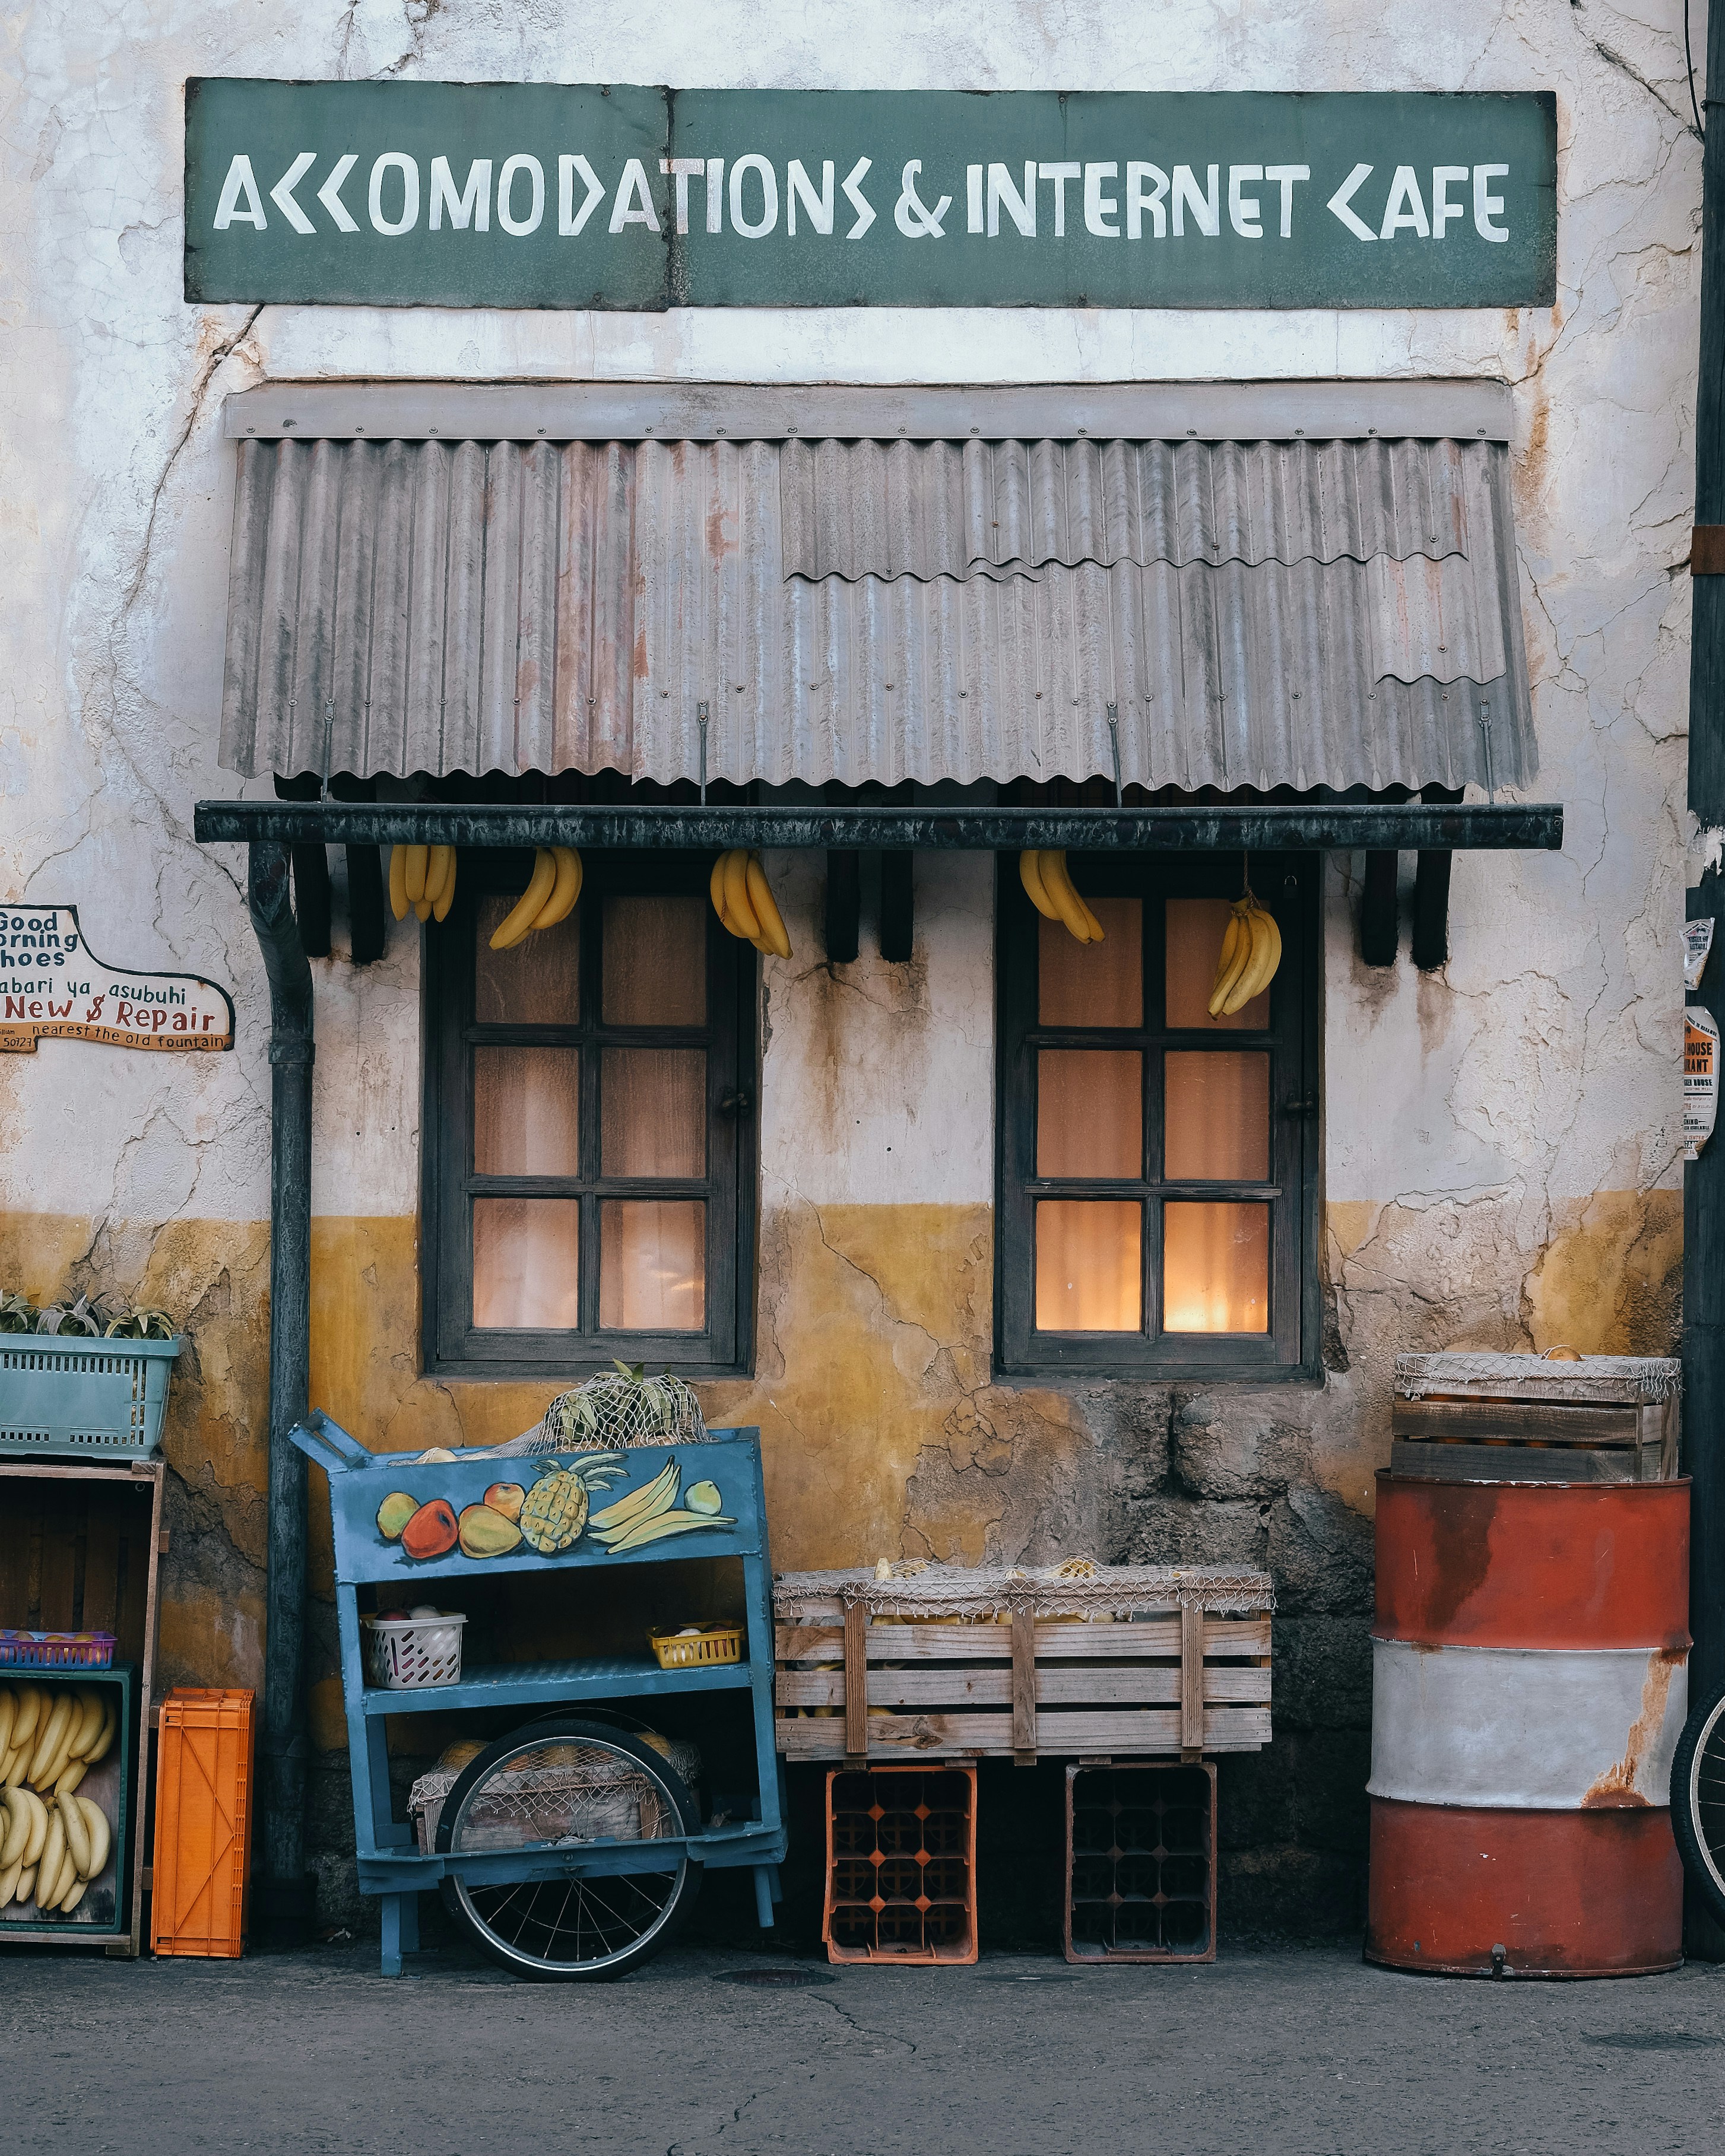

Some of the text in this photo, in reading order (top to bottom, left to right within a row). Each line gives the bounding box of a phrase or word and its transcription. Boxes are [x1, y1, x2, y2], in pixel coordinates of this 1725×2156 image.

[212, 151, 1510, 243] ACCOMODATIONS & INTERNET CAFE
[0, 912, 58, 931] Good
[67, 981, 91, 998] ya
[109, 984, 186, 1005] asubuhi
[5, 995, 74, 1019] New
[115, 1001, 215, 1033] Repair
[32, 1025, 224, 1047] nearest the old fountain
[1687, 1042, 1713, 1056] HOUSE
